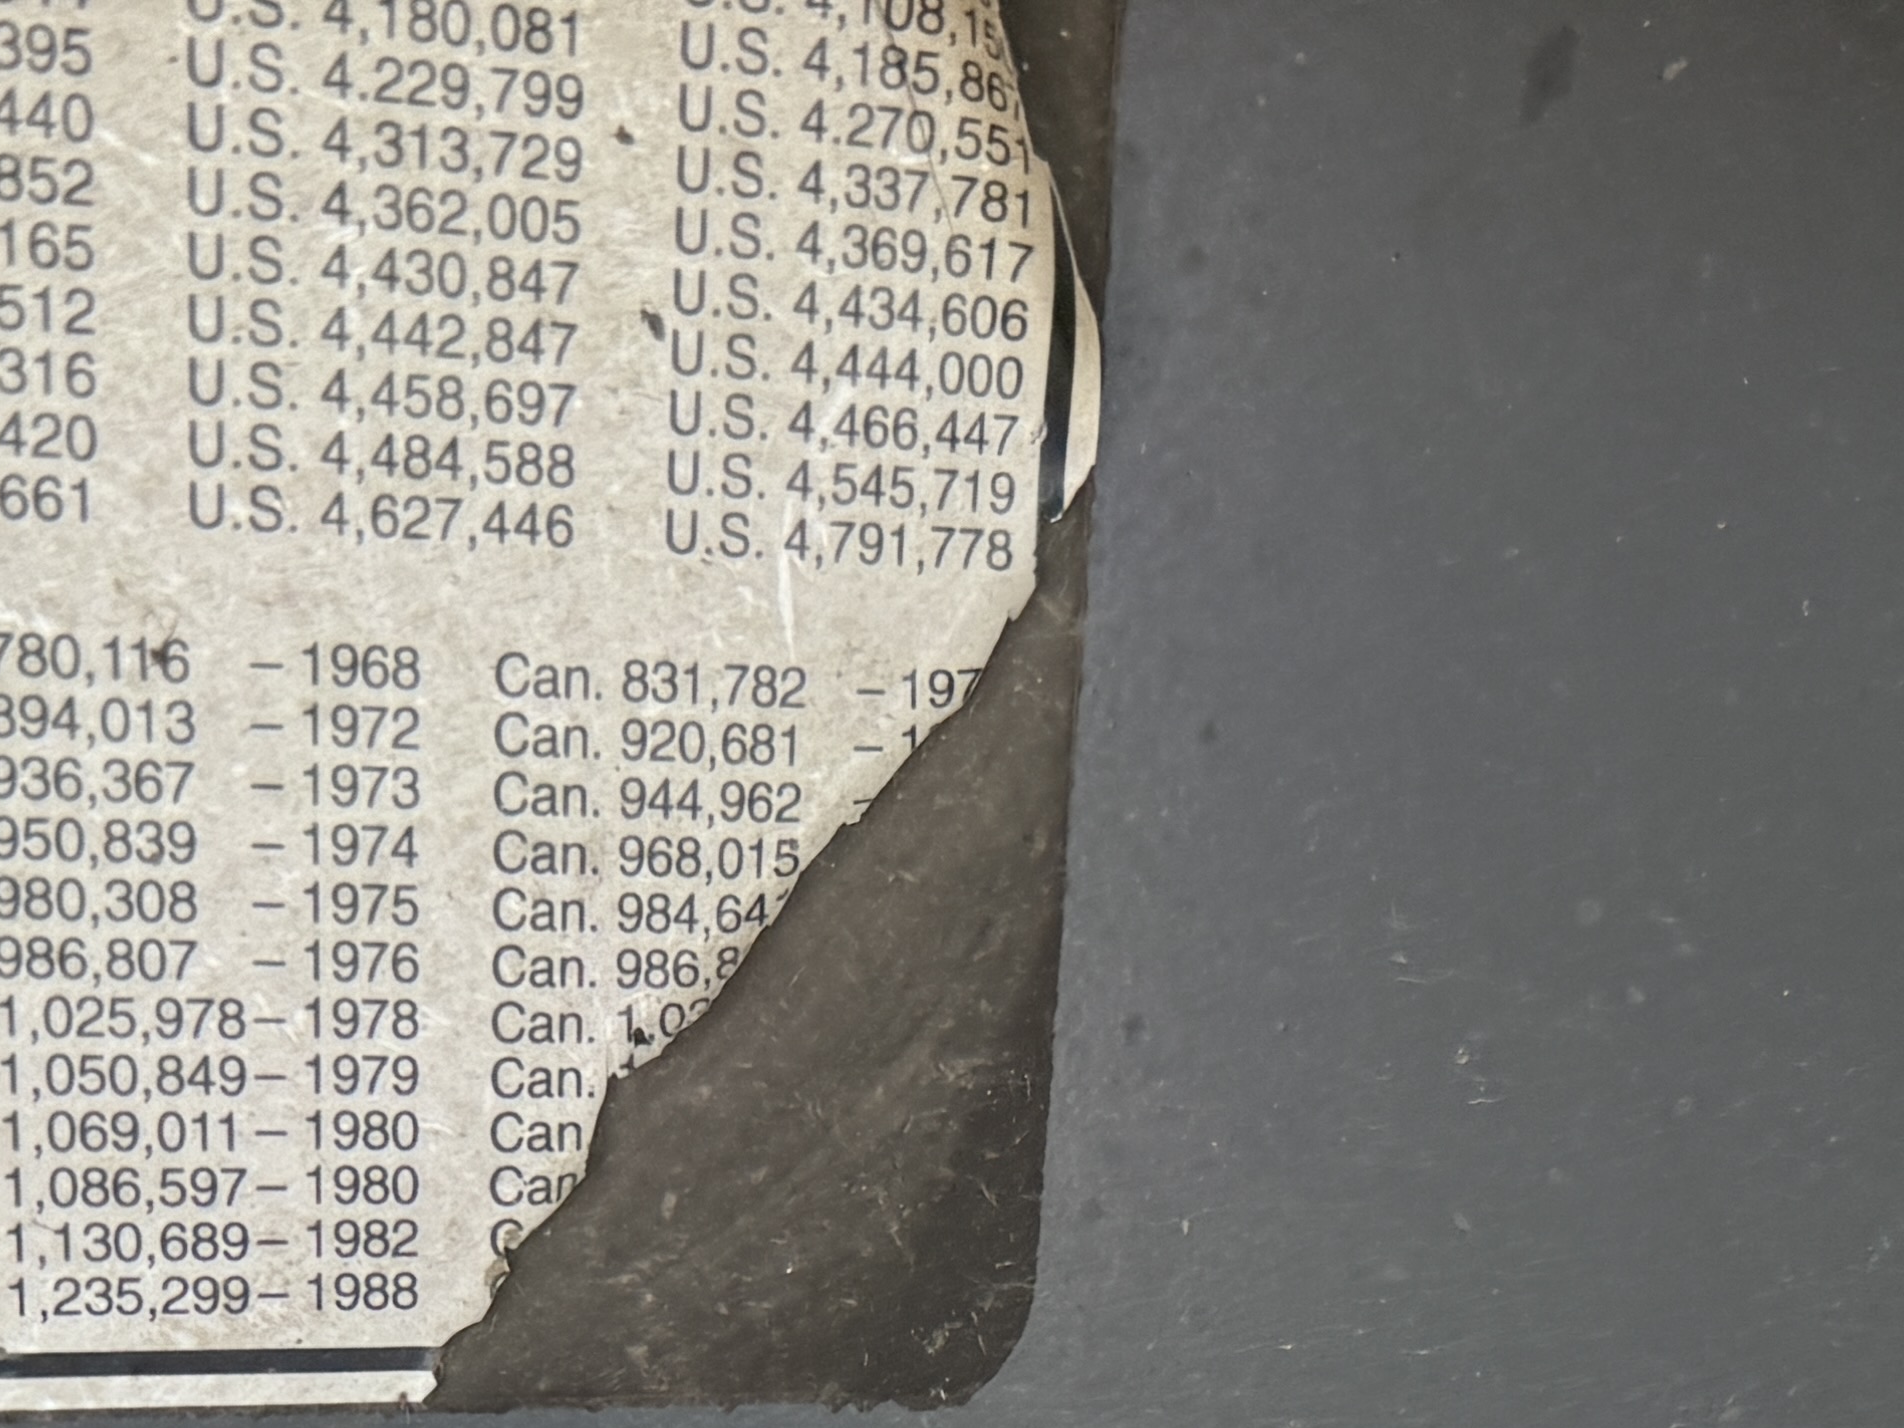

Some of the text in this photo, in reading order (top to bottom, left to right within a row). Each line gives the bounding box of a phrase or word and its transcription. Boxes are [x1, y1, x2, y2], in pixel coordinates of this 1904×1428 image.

[187, 36, 298, 94] U.S.
[680, 20, 781, 77] U.S.
[678, 83, 779, 138] U.S.
[186, 102, 582, 183] U.S. 4,313,729
[187, 166, 581, 244] U.S. 4,362,005
[677, 145, 1028, 228] U.S. 4,337,781
[188, 231, 579, 306] U.S. 4,430,847
[675, 206, 1034, 282] U.S. 4,369,617
[188, 294, 578, 367] U.S. 4,442,847
[673, 268, 1028, 342] U.S. 4,434,606
[188, 357, 577, 429] U.S. 4,458,697
[671, 329, 1023, 400] U.S. 4,444,000
[188, 420, 575, 490] U.S. 4,484,588
[669, 389, 1019, 459] U.S. 4,466,447
[667, 449, 1015, 516] U.S. 4,545,719
[189, 481, 573, 551] U.S. 4,627,446
[666, 509, 1012, 574] U.S. 4,791,778
[493, 651, 806, 712] Can. 831,782
[494, 711, 796, 771] Can. 920,681
[493, 770, 801, 828] Can. 944,962
[493, 829, 799, 886] Can. 968,015
[492, 886, 597, 933] Can.
[492, 943, 596, 988] Can.
[1, 1053, 247, 1103] 1,050,849
[2, 1110, 235, 1159] 1,069,011
[5, 1166, 247, 1214] 1,086,597
[7, 1218, 250, 1269] 1,130,689
[8, 1271, 250, 1323] 1,235,299
